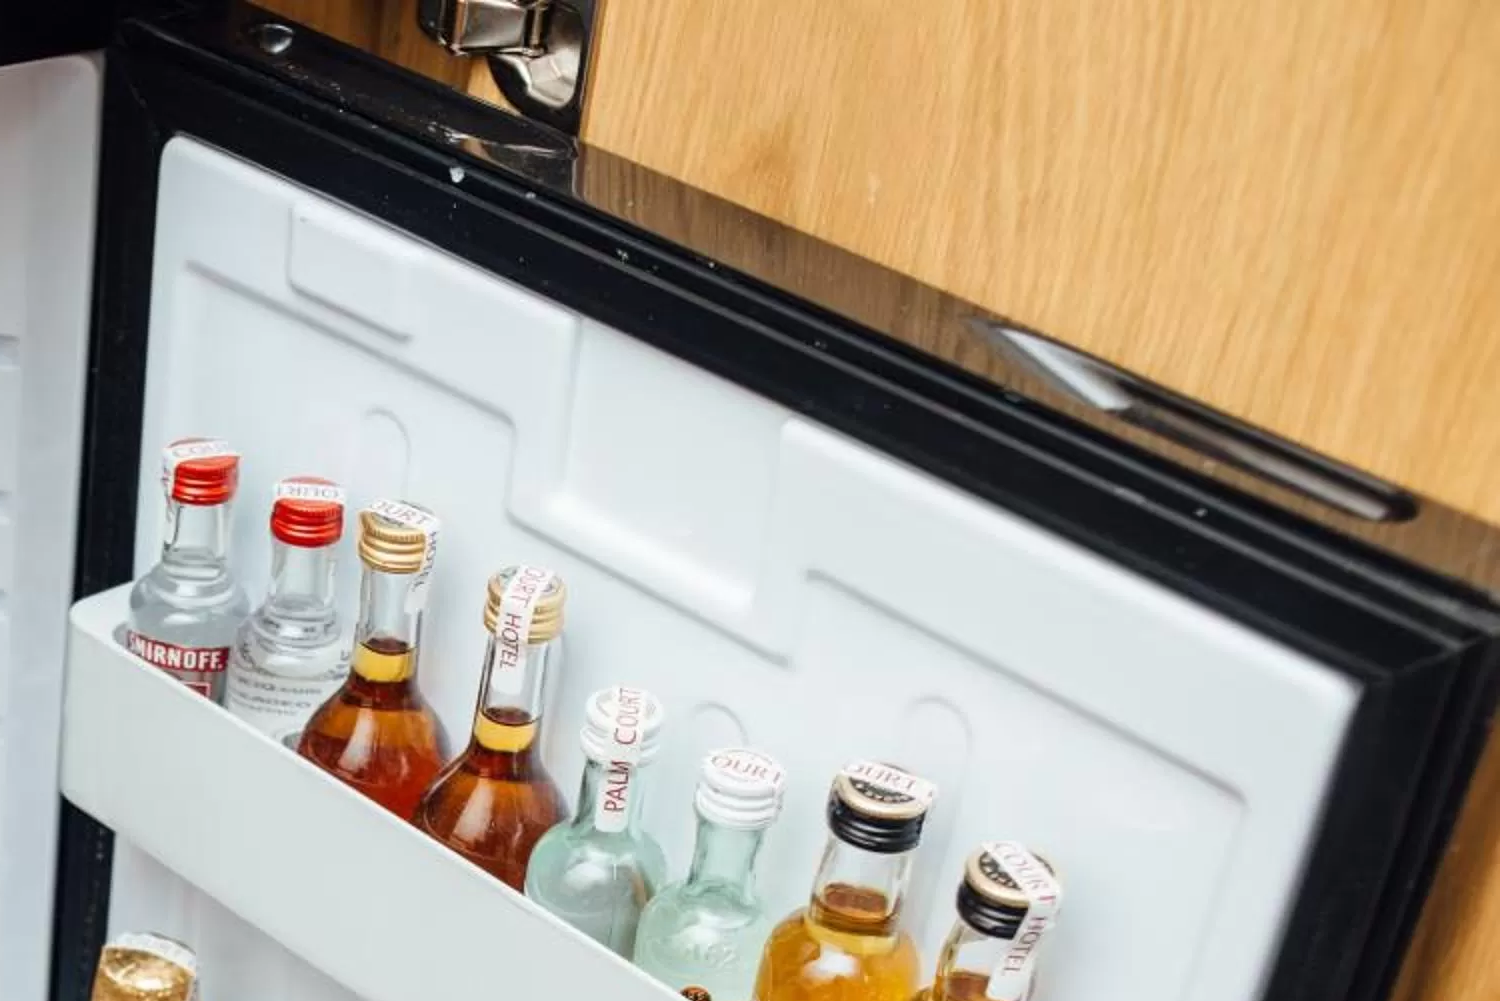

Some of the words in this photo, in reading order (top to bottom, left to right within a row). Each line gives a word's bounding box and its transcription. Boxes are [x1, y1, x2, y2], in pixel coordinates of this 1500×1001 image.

[499, 612, 524, 670] HOTEL
[613, 687, 643, 746] COURT
[604, 760, 632, 814] PALM
